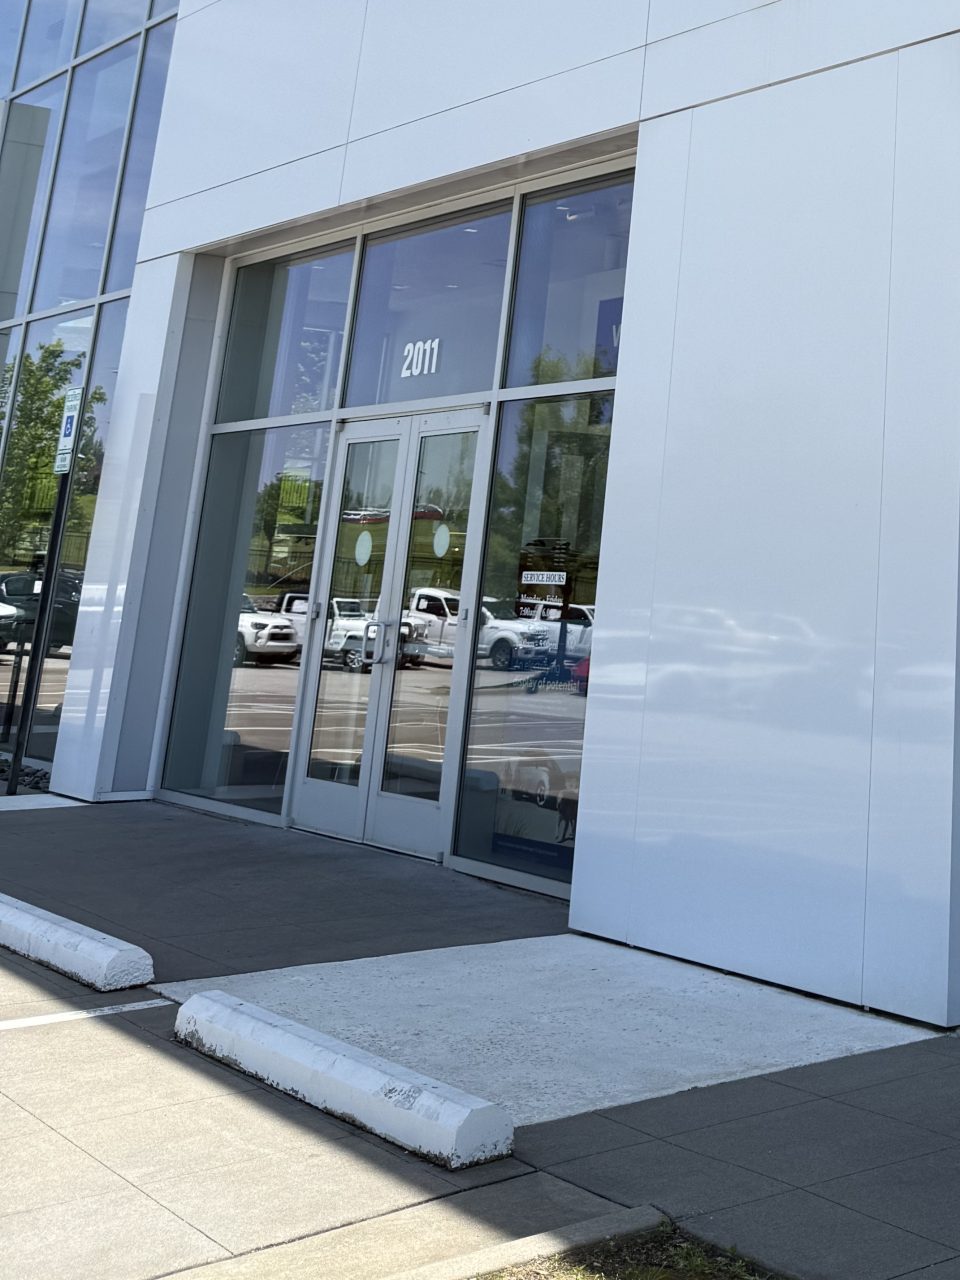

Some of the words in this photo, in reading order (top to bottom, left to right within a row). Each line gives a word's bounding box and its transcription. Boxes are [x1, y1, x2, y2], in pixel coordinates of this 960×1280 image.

[401, 337, 440, 378] 2011
[523, 572, 545, 583] SERVICE
[545, 573, 565, 584] HOURS
[546, 679, 580, 693] potential
